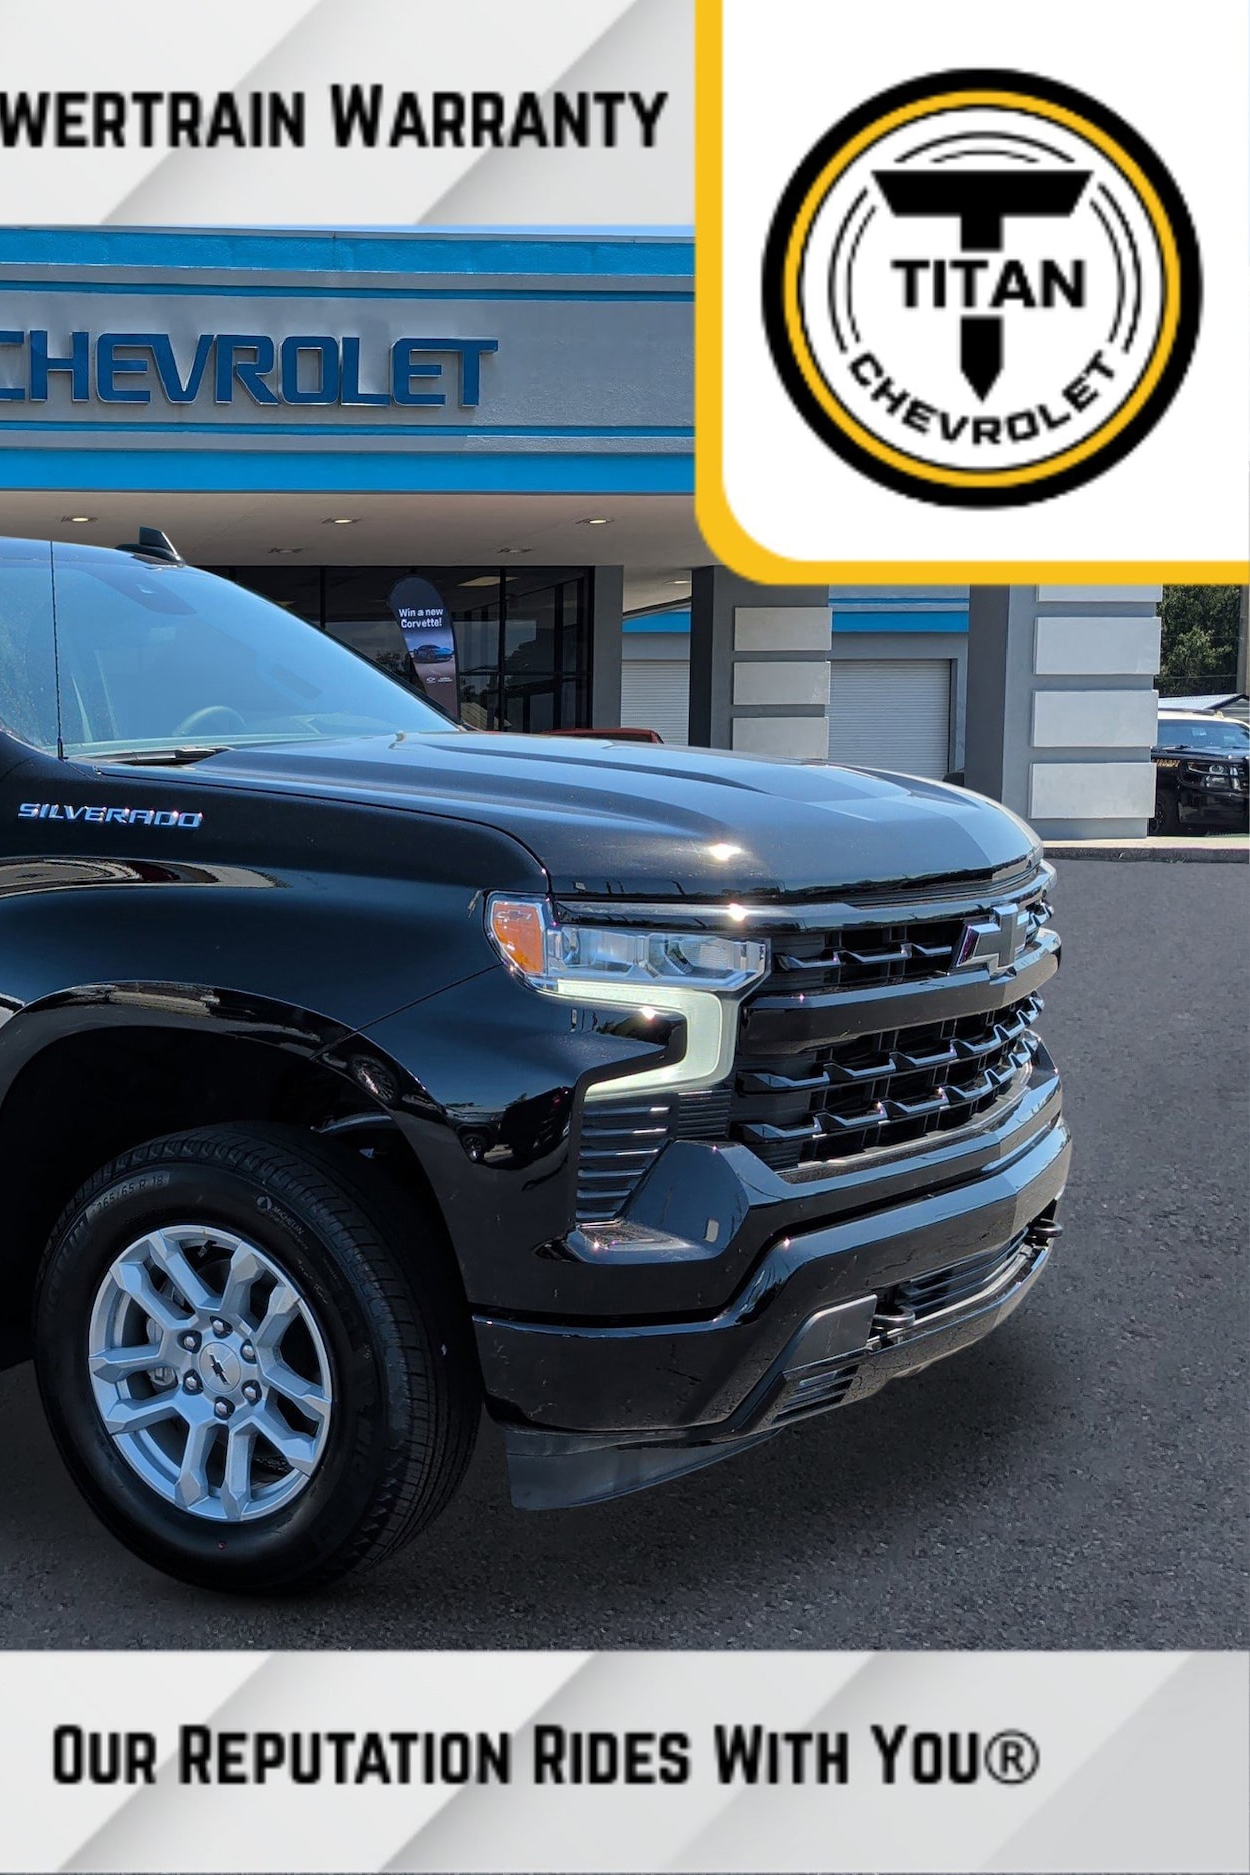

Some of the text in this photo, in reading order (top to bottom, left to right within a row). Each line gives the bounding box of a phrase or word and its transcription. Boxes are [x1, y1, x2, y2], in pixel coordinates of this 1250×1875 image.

[399, 608, 444, 617] Win a new
[400, 618, 442, 628] Corvette!
[17, 802, 204, 829] SILVERADO
